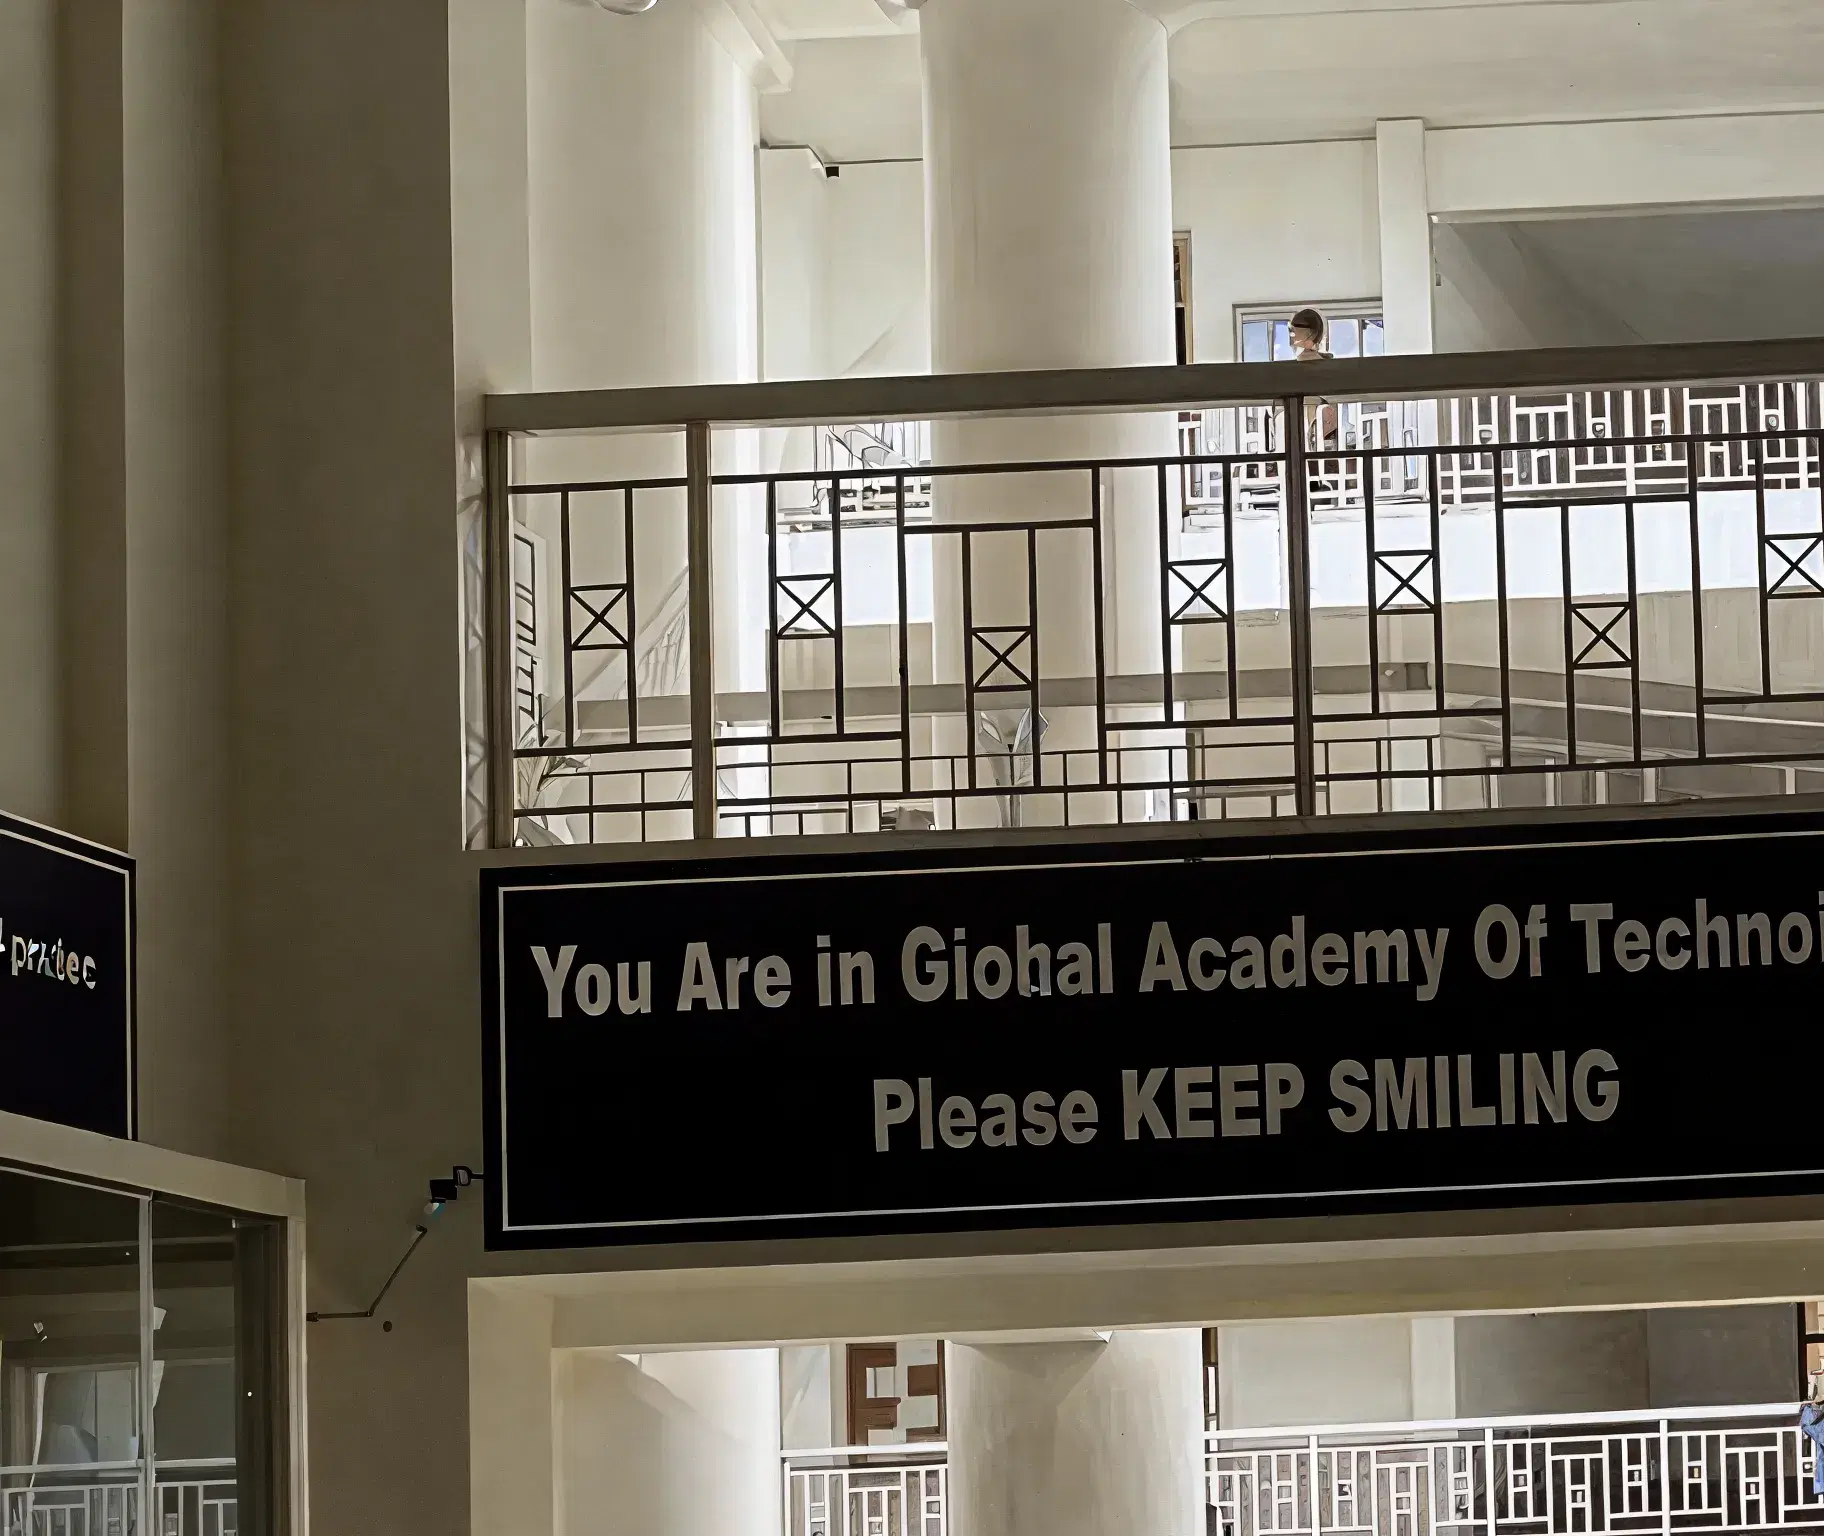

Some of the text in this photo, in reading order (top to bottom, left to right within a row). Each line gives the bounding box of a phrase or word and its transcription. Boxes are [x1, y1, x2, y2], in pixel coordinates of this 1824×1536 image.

[530, 945, 652, 1019] You
[677, 942, 792, 1012] Are
[817, 935, 876, 1007] in
[1139, 915, 1450, 1002] Academy
[1474, 904, 1548, 980] Of
[874, 1049, 1620, 1153] Please KEEP SMILING
